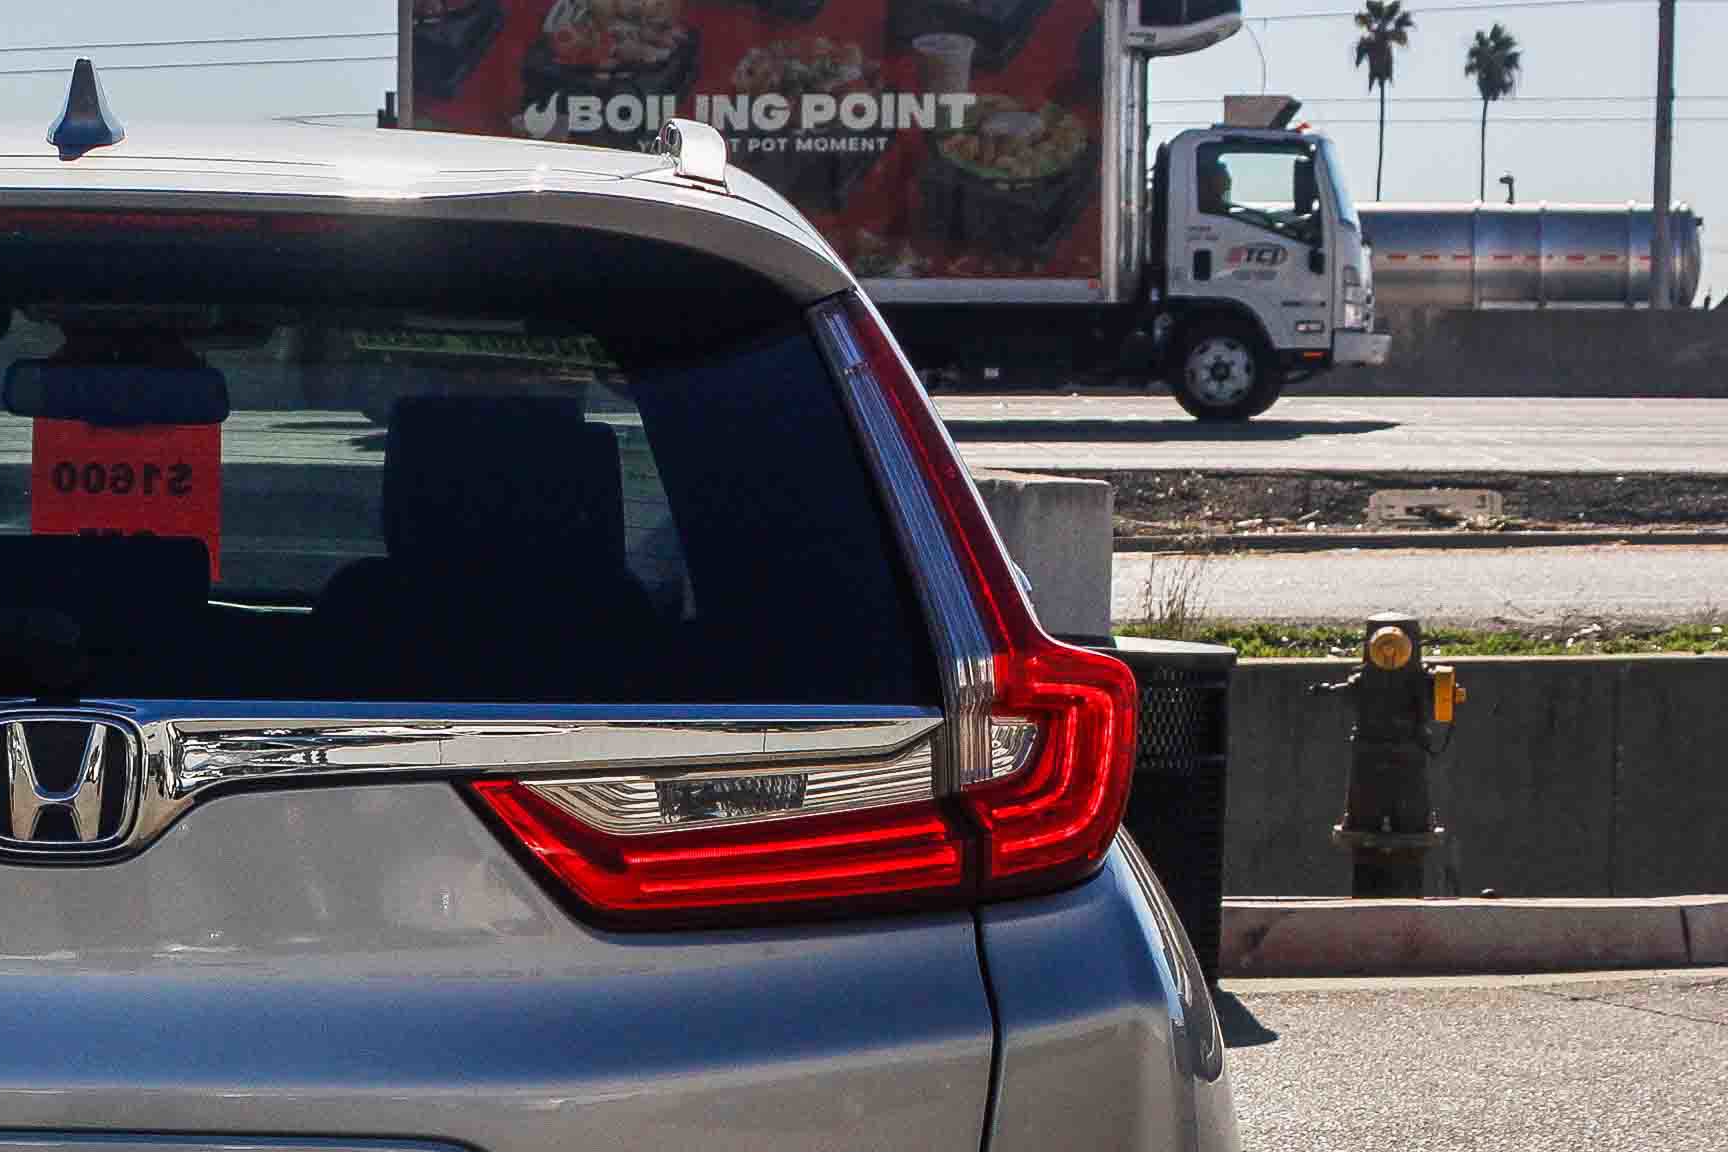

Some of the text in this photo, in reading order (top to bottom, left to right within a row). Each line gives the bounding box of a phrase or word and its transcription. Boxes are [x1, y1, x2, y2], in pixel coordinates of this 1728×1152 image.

[802, 93, 978, 130] POINT
[747, 138, 790, 153] POT
[795, 137, 889, 153] MOMENT
